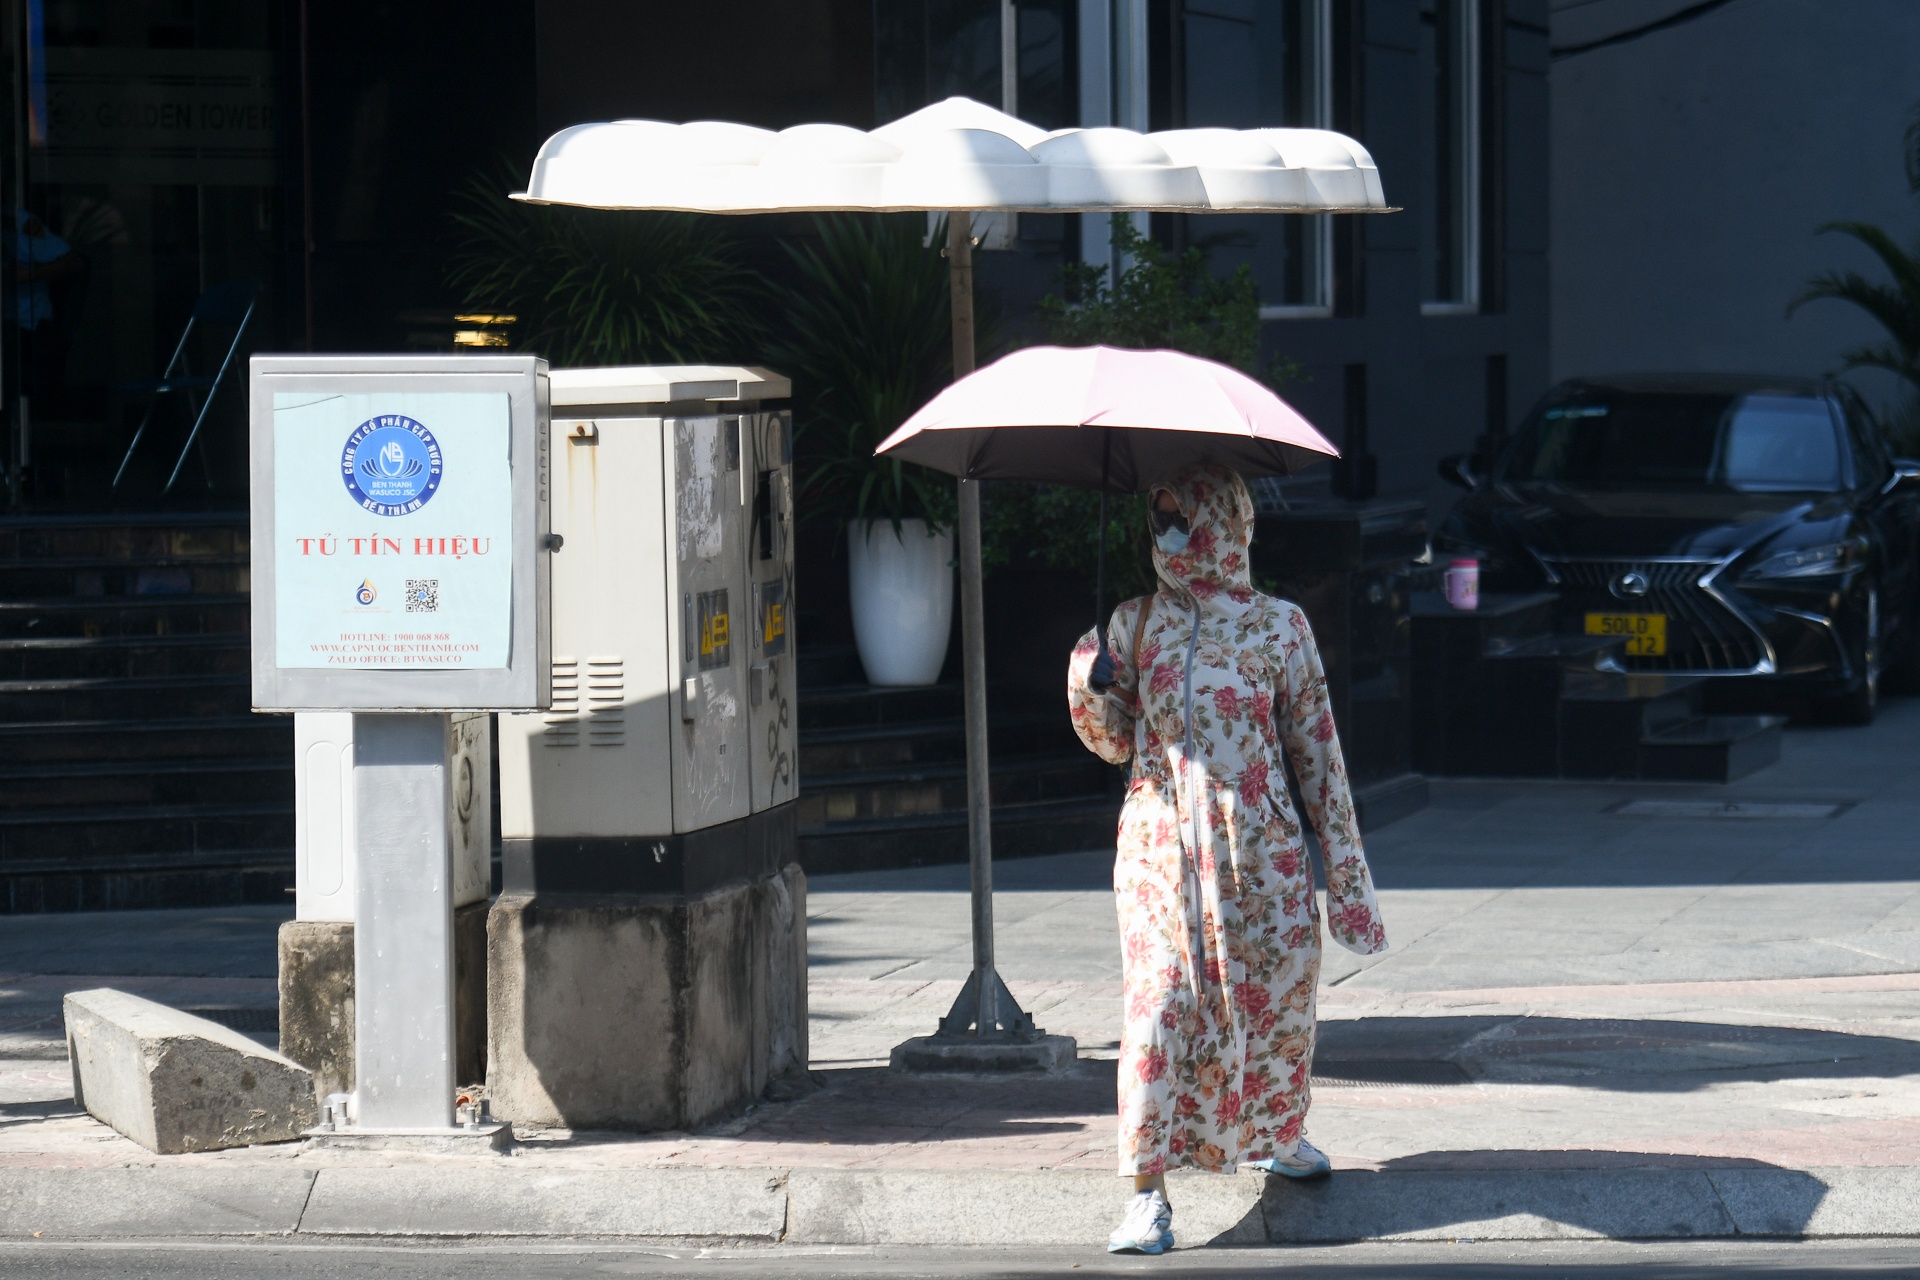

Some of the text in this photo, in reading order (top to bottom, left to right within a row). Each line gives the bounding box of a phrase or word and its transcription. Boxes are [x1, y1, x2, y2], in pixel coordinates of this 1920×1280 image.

[351, 433, 363, 445] TY
[296, 532, 491, 560] TỦ TÍN HIỆU
[403, 655, 462, 663] BTWASUCO
